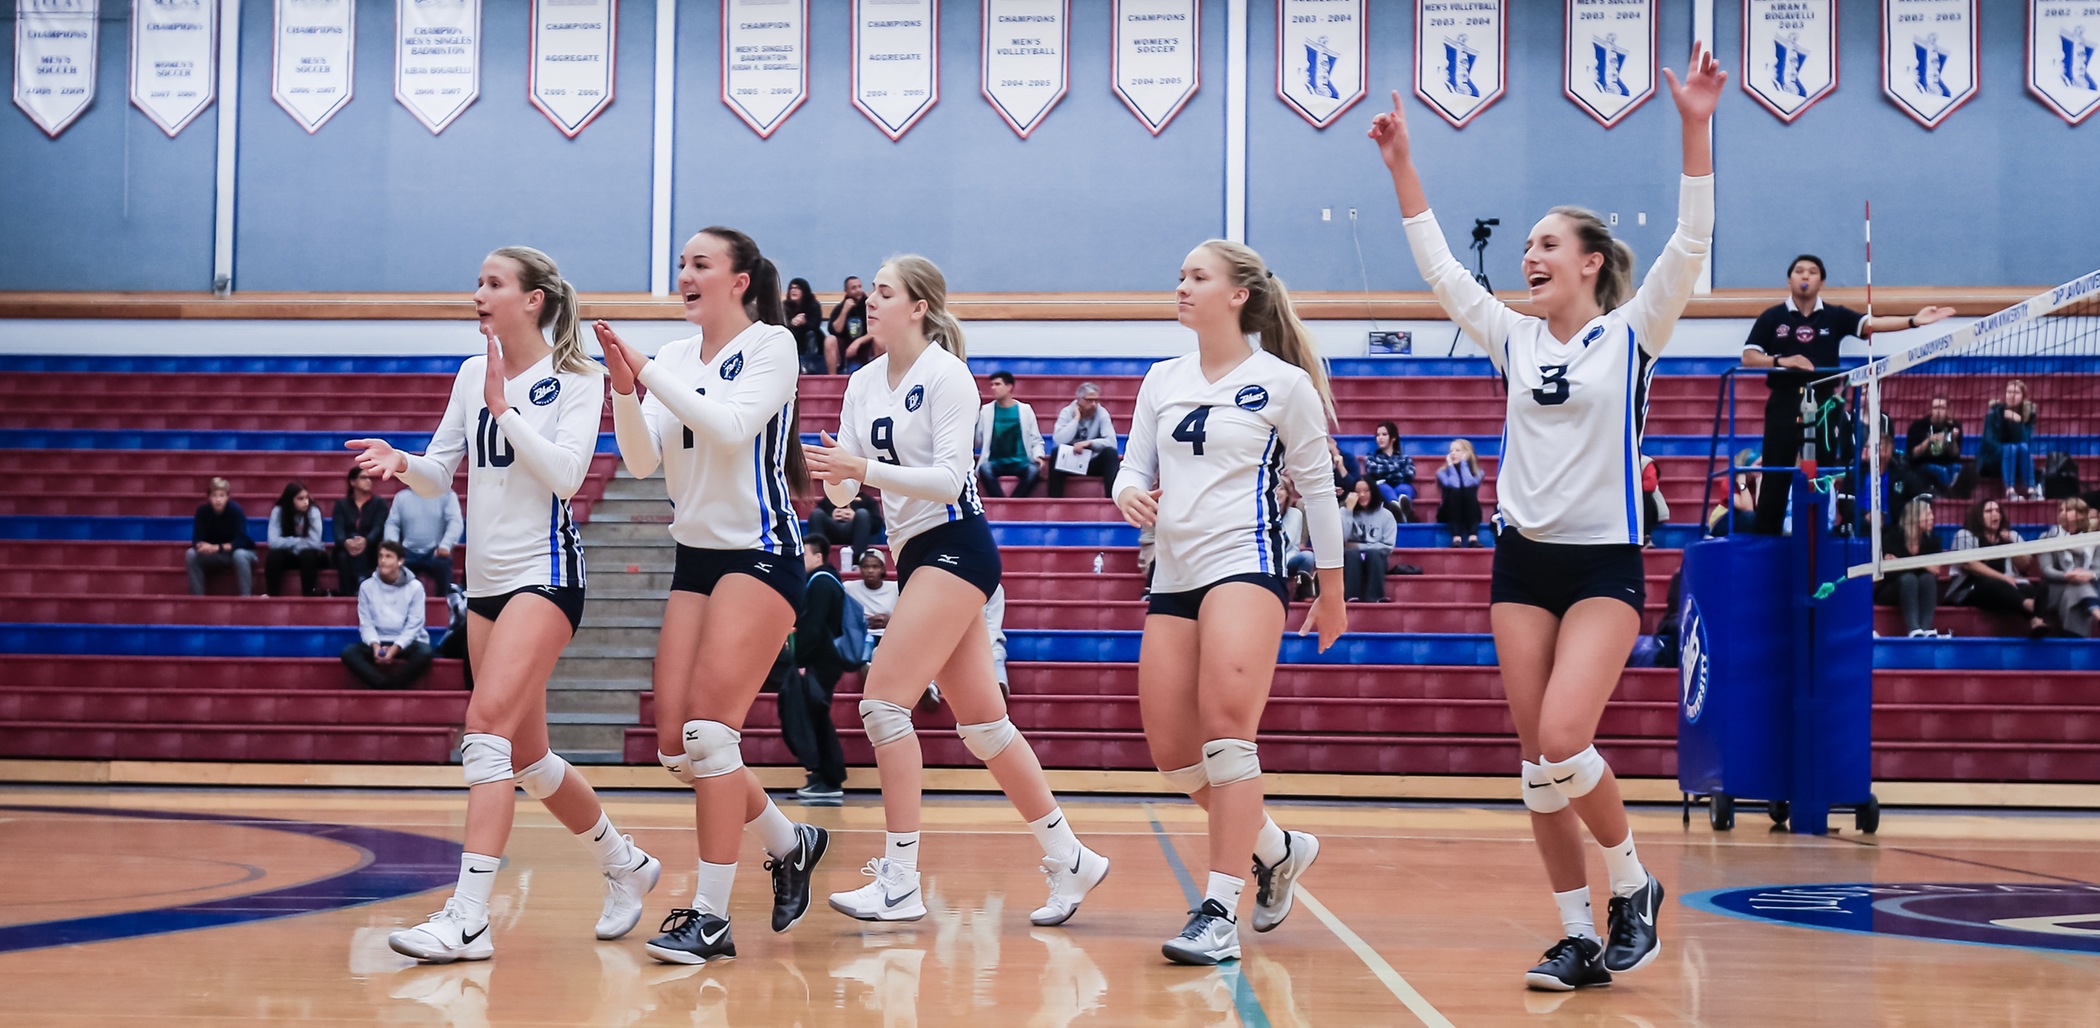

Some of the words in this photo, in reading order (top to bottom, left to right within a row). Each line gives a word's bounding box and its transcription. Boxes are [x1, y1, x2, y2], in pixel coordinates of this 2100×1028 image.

[1425, 3, 1448, 11] MEN'S
[1450, 2, 1497, 11] VOLLEYBALL
[1771, 3, 1800, 11] KIRAN
[998, 15, 1056, 23] CHAMPIONS
[1127, 13, 1186, 22] CHAMPIONS
[1292, 15, 1317, 24] 2003
[1327, 14, 1352, 23] 2004
[1616, 11, 1641, 20] 2004
[740, 21, 791, 30] CHAMPION
[867, 20, 922, 28] CHAMPIONS
[1430, 18, 1455, 26] 2003
[1465, 17, 1491, 26] 2004
[286, 26, 343, 34] CHAMPIONS
[545, 22, 602, 30] CHAMPIONS
[1011, 38, 1041, 46] MEN'S
[1133, 38, 1179, 46] WOMEN'S
[735, 45, 759, 53] MEN'S
[761, 45, 794, 53] SINGLES
[996, 47, 1056, 55] VOLLEYBALL
[1137, 45, 1176, 54] SOCCER
[545, 54, 600, 62] AGGREGATE
[740, 54, 788, 62] BADMINTON
[869, 53, 922, 61] AGGREGATE
[544, 88, 567, 96] 2005
[1531, 364, 1570, 406] 3
[1171, 404, 1214, 456] 4
[477, 406, 521, 468] 10
[871, 416, 901, 467] 9
